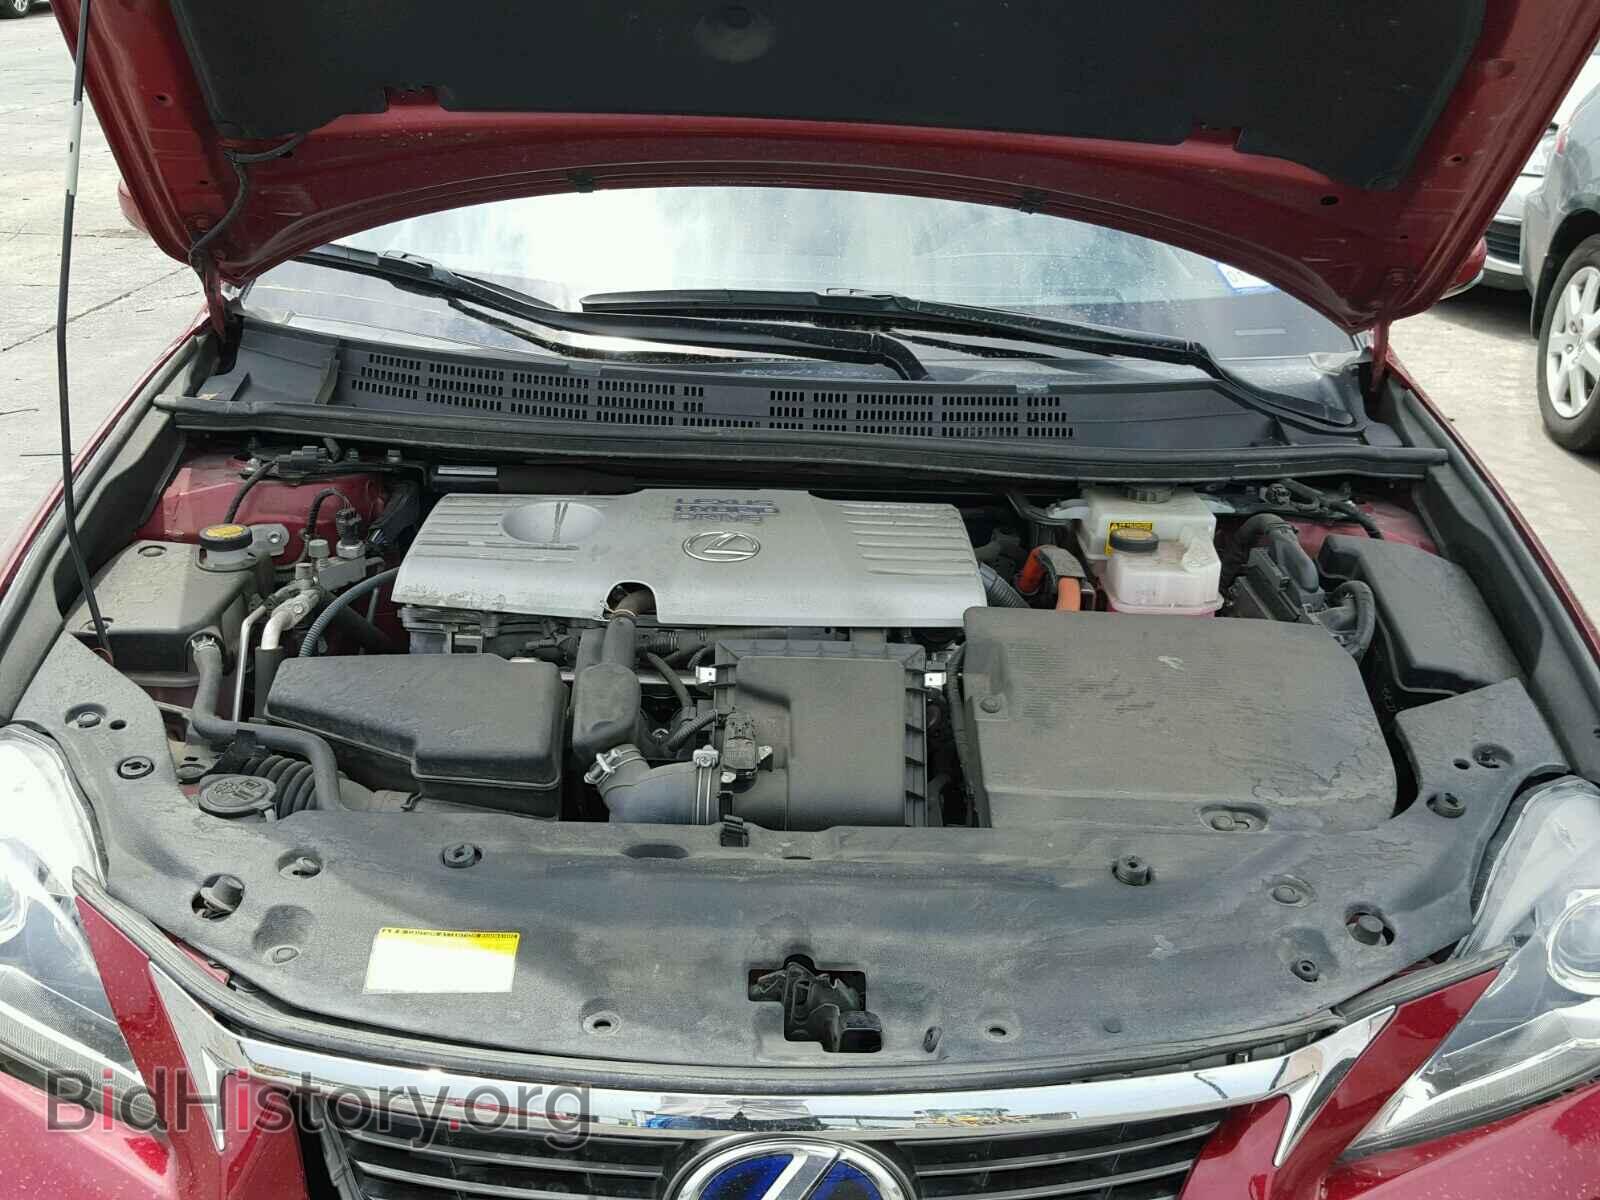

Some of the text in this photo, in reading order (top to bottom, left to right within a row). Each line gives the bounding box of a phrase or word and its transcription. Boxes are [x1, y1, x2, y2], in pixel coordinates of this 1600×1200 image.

[674, 497, 774, 506] LEXUS
[674, 505, 780, 514] HYBRID
[672, 513, 764, 522] DRIVE
